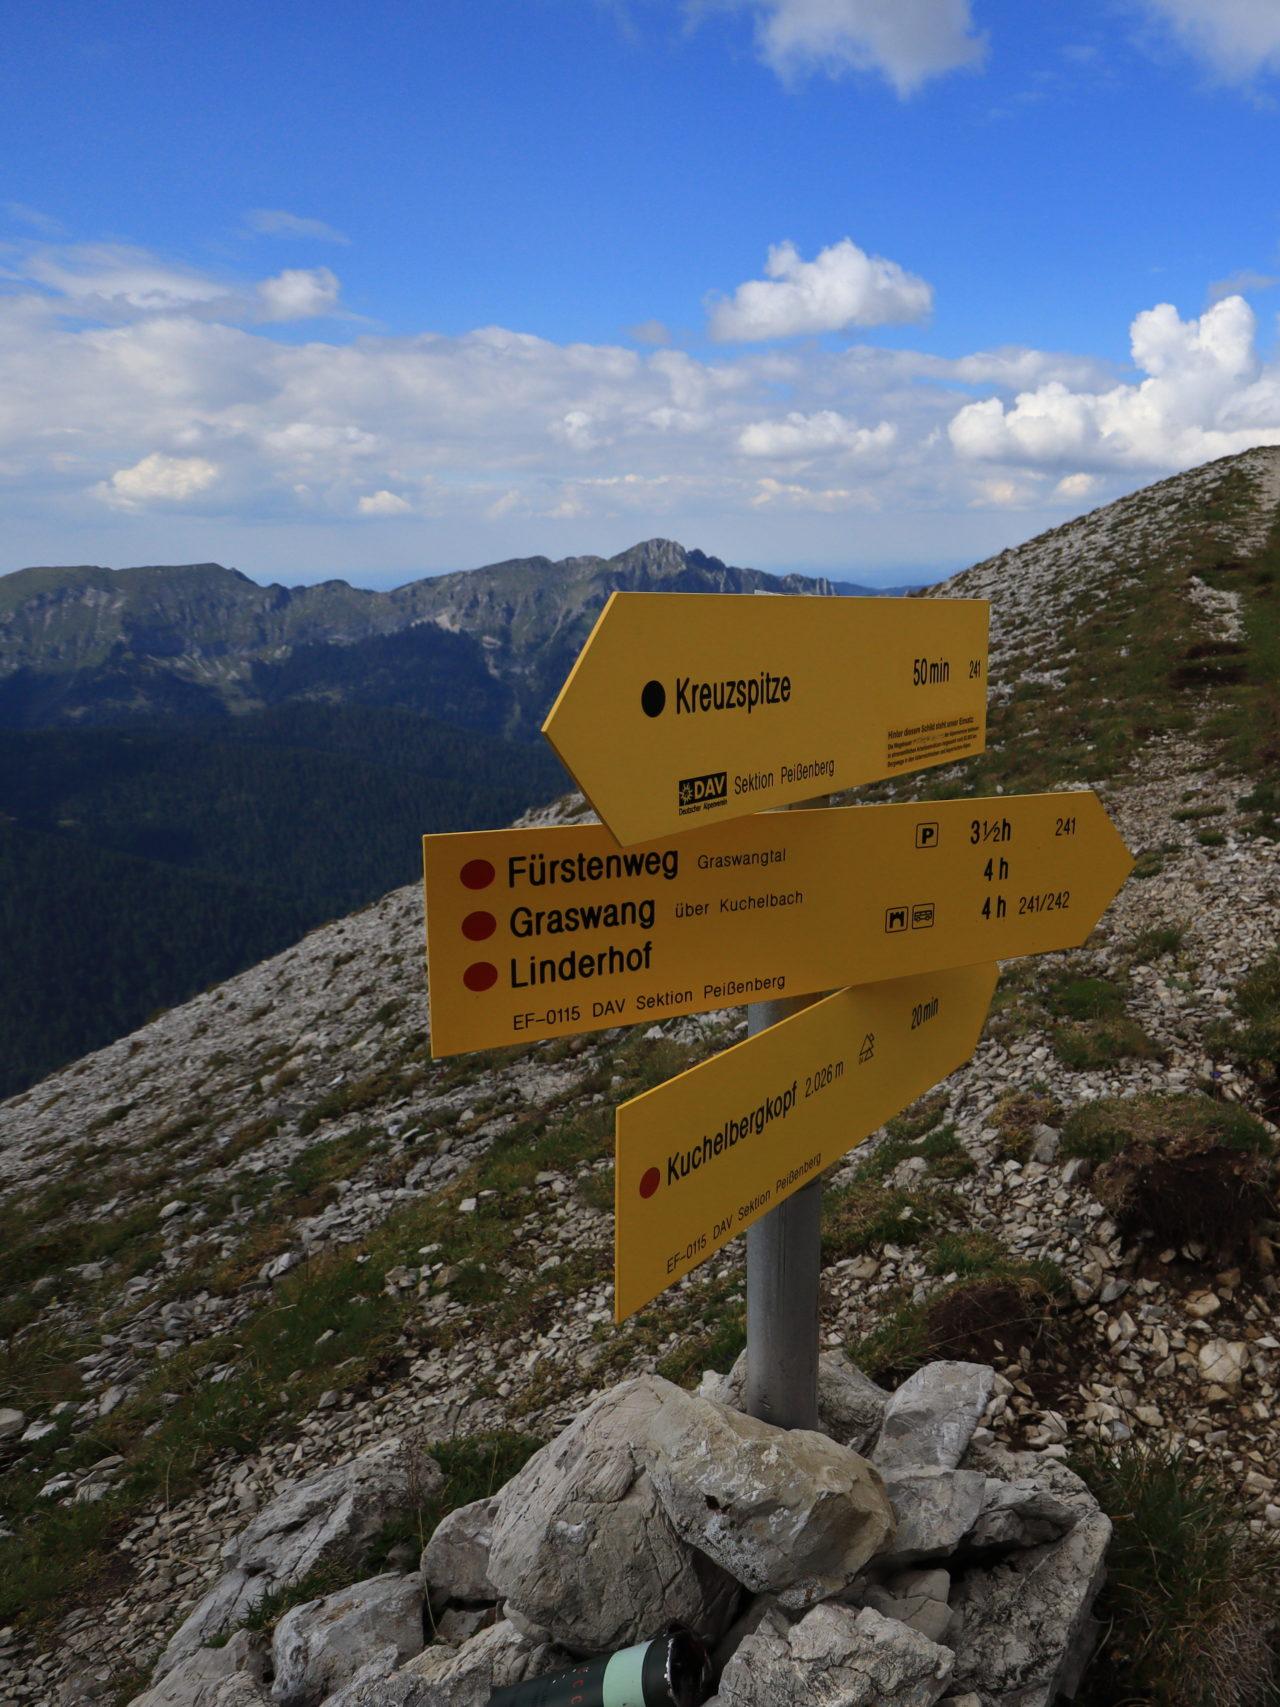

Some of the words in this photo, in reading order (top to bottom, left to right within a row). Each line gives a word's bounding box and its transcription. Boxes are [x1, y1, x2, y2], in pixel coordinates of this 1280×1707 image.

[969, 660, 981, 679] 241
[675, 670, 792, 715] Kreuzspitze
[694, 775, 726, 800] DAV
[734, 771, 774, 795] Sektion
[780, 759, 835, 785] Peißenberg
[679, 805, 702, 816] Deutscher
[703, 799, 728, 811] Alpenverein
[921, 827, 935, 845] P
[1054, 816, 1076, 837] 241
[508, 849, 679, 888] Fürstenweg
[697, 847, 786, 870] Graswangtal
[983, 858, 994, 881] 4
[999, 857, 1009, 880] h
[675, 900, 709, 919] über
[720, 890, 803, 913] Kuchelbach
[981, 897, 991, 920] 4
[996, 895, 1007, 918] h
[1018, 891, 1070, 915] 241/242
[510, 898, 656, 938] Graswang
[510, 940, 653, 989] Linderhof
[513, 1005, 581, 1031] EF-0115
[592, 999, 626, 1018] DAV
[636, 988, 693, 1011] Sektion
[704, 974, 786, 1000] Peißenberg
[666, 1080, 799, 1186] Kuchelbergkopf
[804, 1064, 834, 1098] 2.026
[835, 1061, 844, 1078] m
[666, 1236, 707, 1275] EF-0115
[713, 1214, 733, 1239] DAV
[737, 1189, 771, 1222] Sektion
[776, 1151, 822, 1194] Peißenberg
